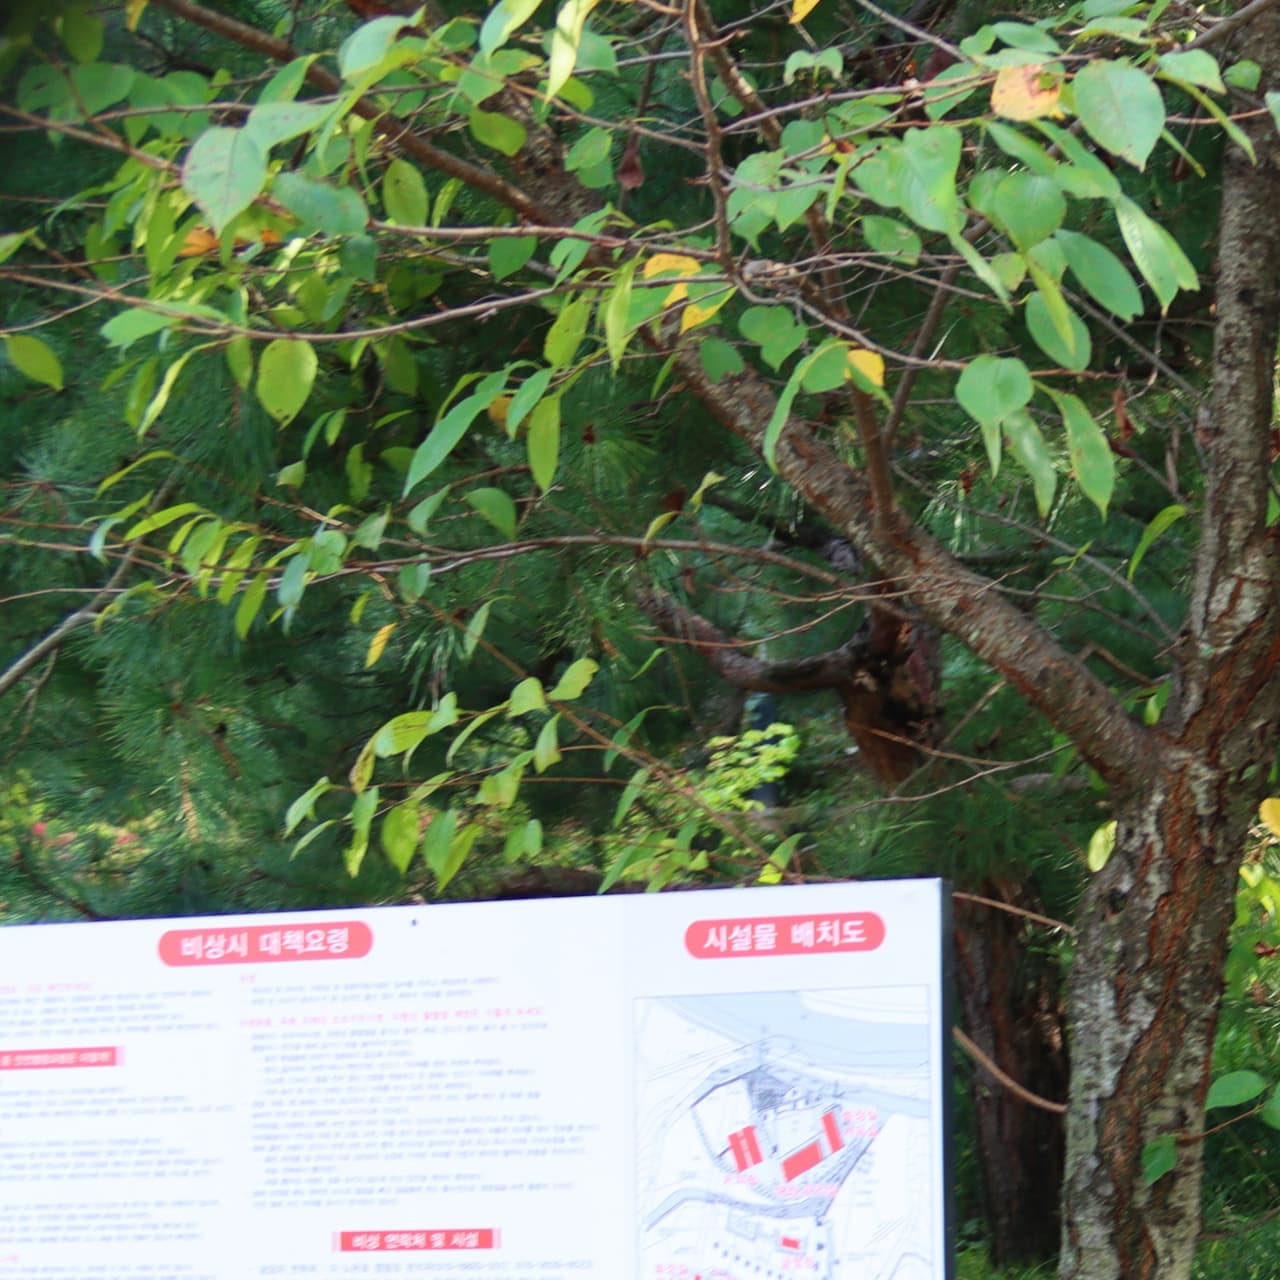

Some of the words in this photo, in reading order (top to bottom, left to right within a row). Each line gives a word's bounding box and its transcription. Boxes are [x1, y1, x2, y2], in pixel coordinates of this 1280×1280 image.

[180, 930, 249, 959] 비상시
[259, 926, 349, 957] 대책요령
[702, 920, 779, 953] 시설물
[790, 917, 867, 950] 배치도
